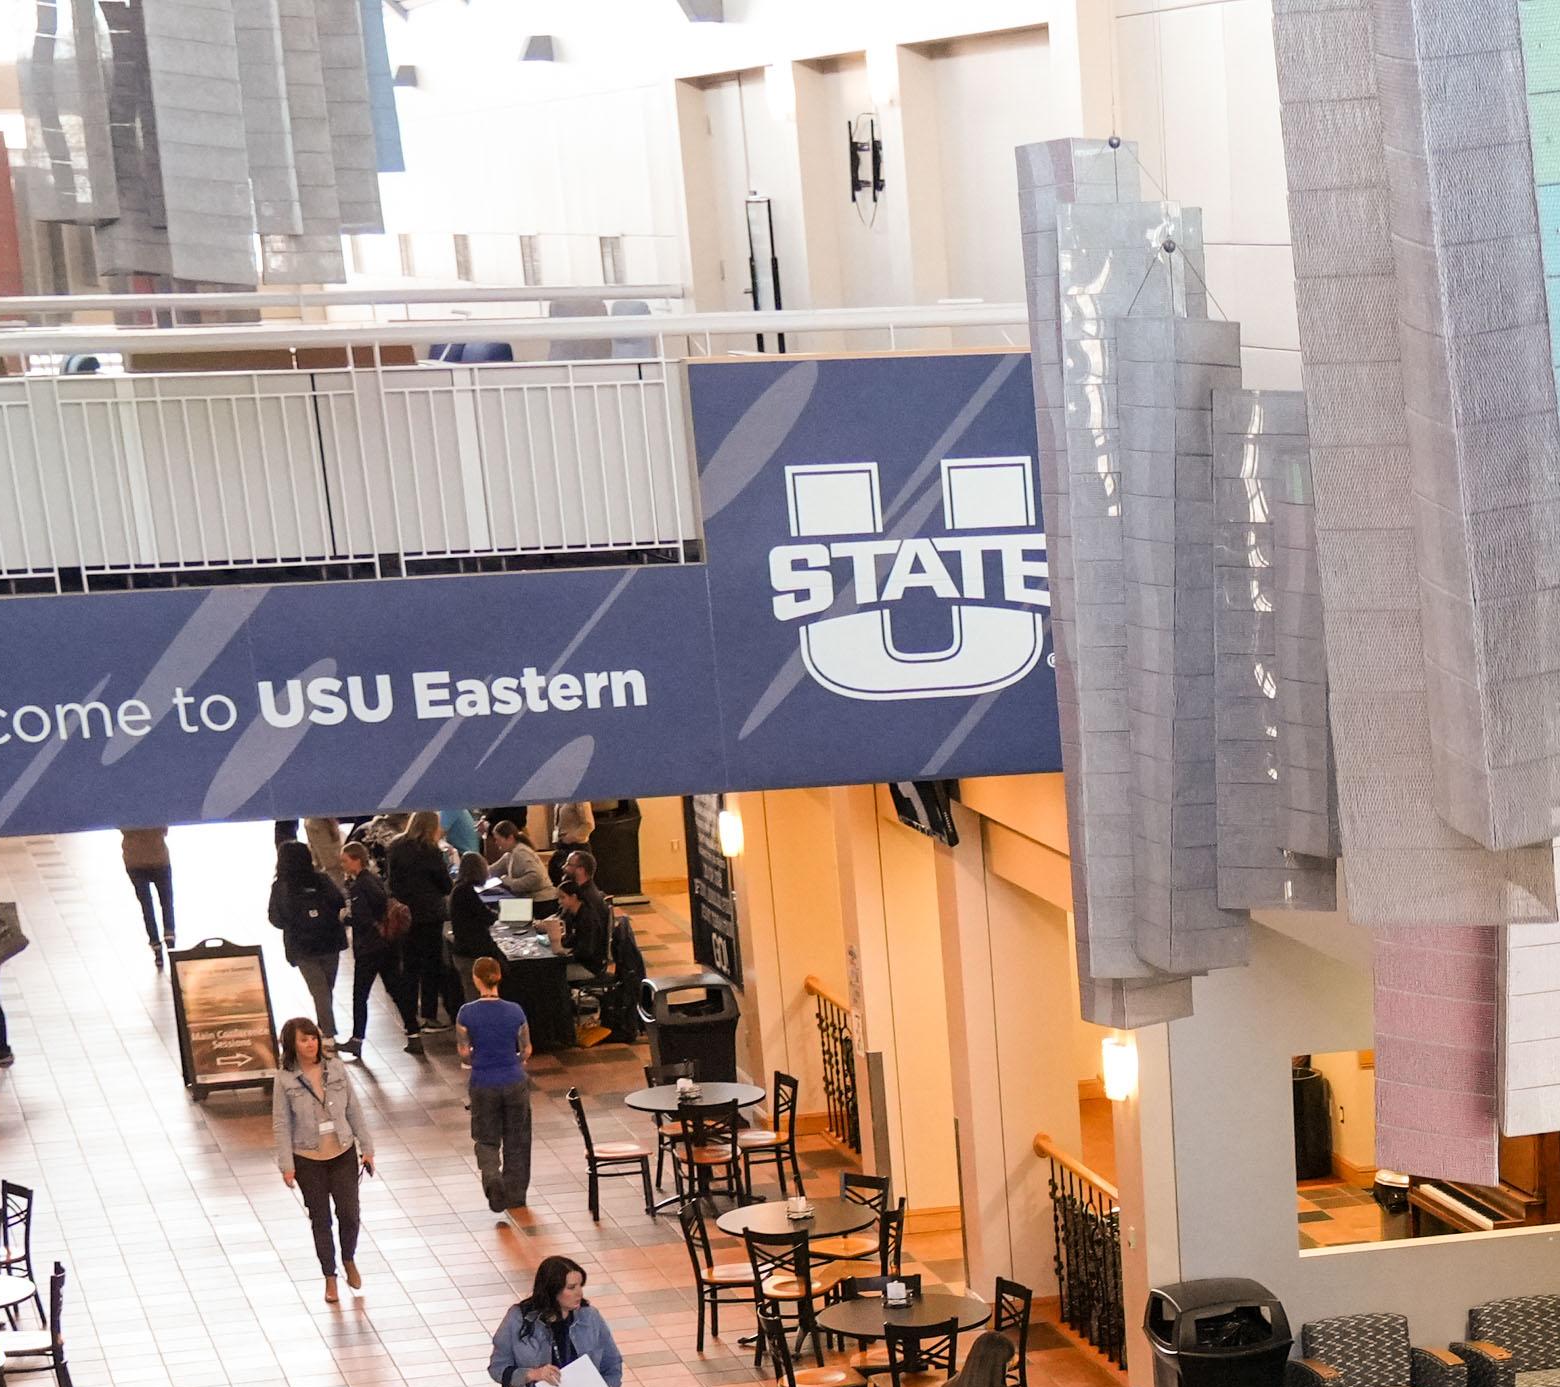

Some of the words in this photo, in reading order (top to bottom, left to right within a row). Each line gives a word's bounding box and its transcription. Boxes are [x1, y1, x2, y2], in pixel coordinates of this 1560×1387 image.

[768, 533, 1051, 621] STATE
[172, 687, 238, 734] to
[257, 673, 394, 728] USU
[412, 667, 648, 720] Eastern
